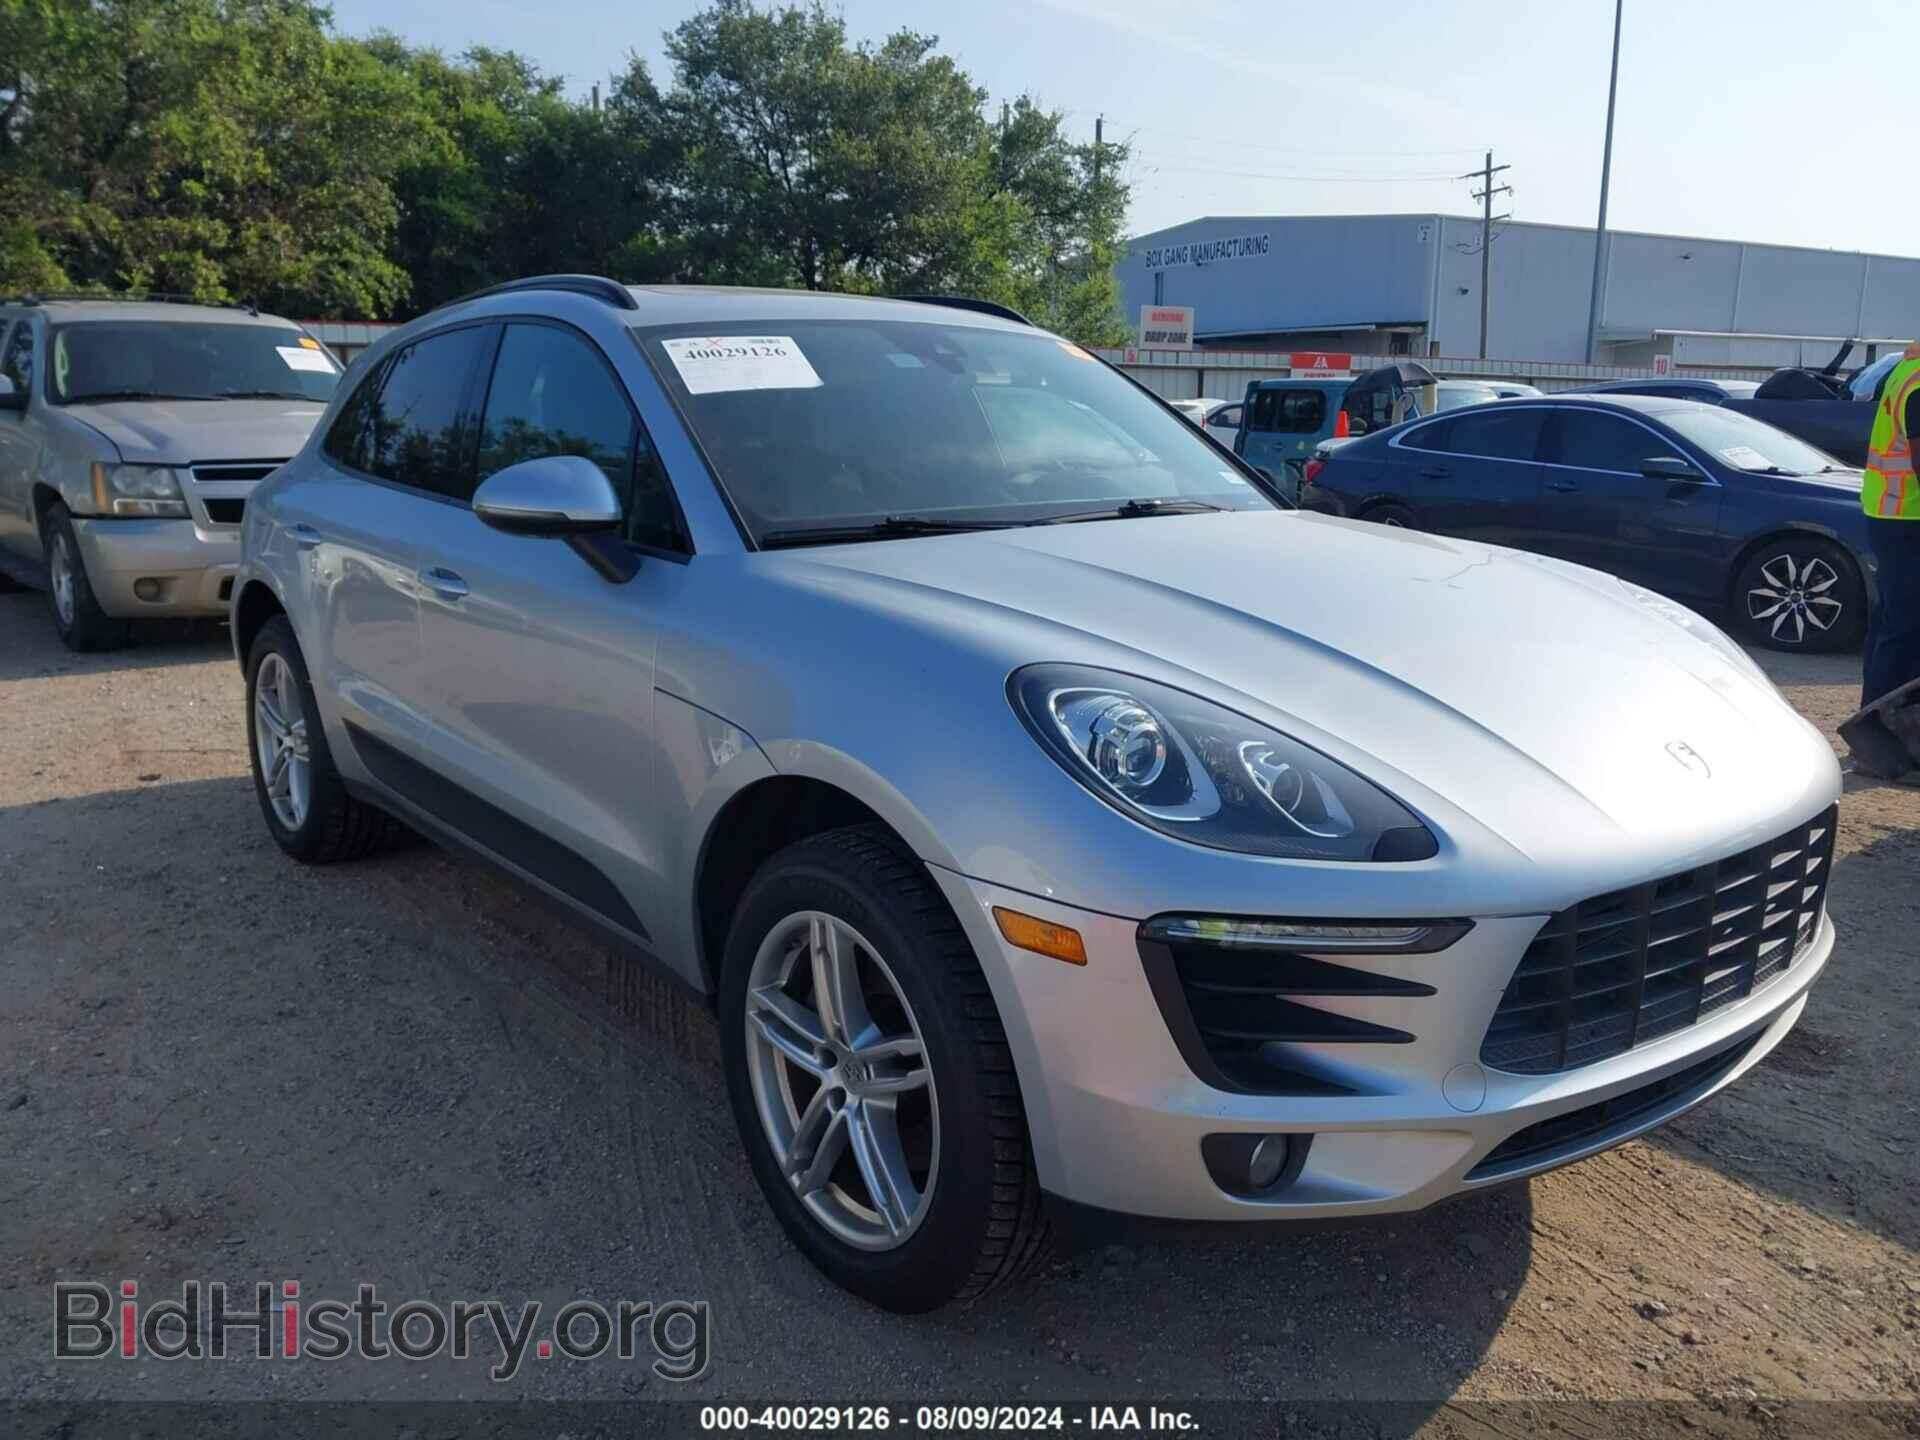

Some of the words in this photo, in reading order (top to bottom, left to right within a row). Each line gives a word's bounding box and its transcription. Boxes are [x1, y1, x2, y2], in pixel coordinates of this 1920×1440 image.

[1145, 250, 1164, 268] BOX
[1164, 246, 1189, 266] GANG
[1189, 235, 1270, 263] MANUFACTURING
[684, 346, 788, 361] 40029126
[1655, 358, 1669, 376] 10
